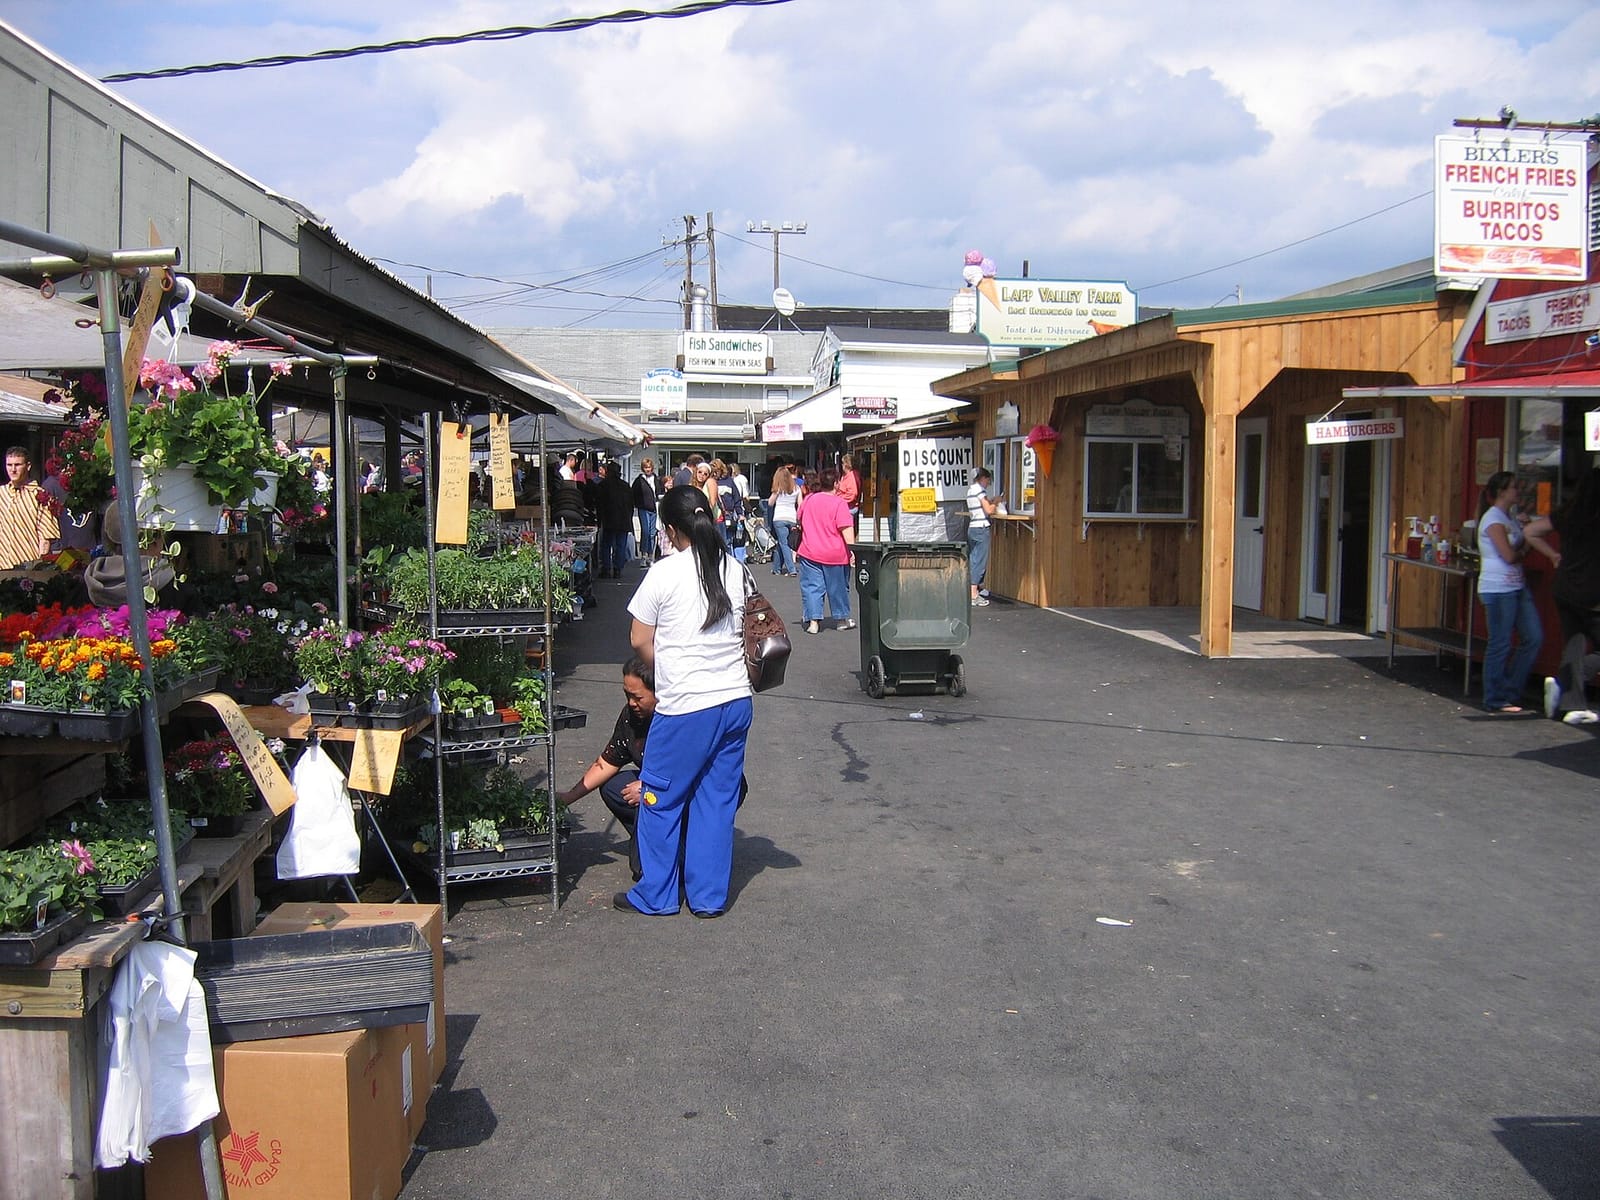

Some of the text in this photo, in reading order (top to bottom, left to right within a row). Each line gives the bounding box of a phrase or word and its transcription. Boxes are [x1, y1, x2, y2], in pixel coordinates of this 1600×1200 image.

[1464, 147, 1559, 165] BIXLER'S
[1446, 164, 1577, 187] FRENCH FRIES
[1463, 200, 1560, 221] BURRITOS
[1480, 222, 1543, 241] TACOS
[1001, 287, 1122, 304] LAPP VALLEY FARM
[1545, 293, 1590, 314] FRENCH
[1091, 308, 1117, 317] Cream
[1551, 311, 1583, 328] FRIES
[1005, 325, 1090, 337] Taste the Difference
[1498, 316, 1531, 333] TACOS
[688, 337, 763, 352] Fish Sandwiches
[718, 359, 727, 367] THE
[729, 359, 746, 367] SEVEN
[747, 359, 762, 368] SEAS
[1315, 423, 1396, 439] HAMBURGERS
[903, 448, 972, 467] DISCOUNT
[909, 469, 969, 488] PERFUME
[254, 1139, 282, 1186] CRAFTED
